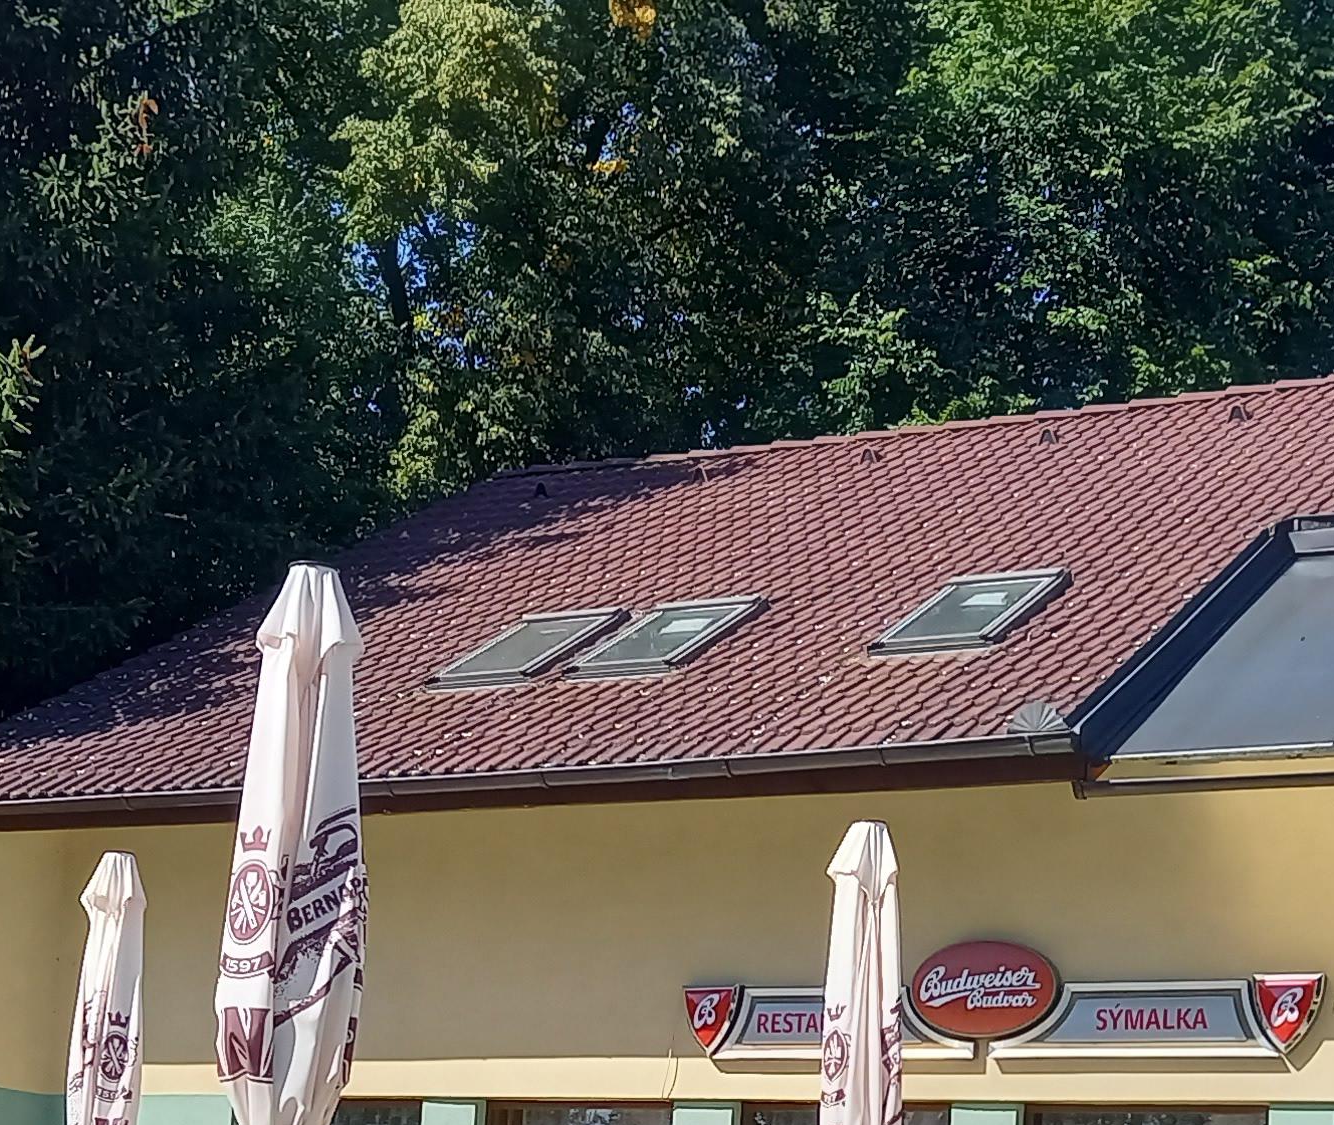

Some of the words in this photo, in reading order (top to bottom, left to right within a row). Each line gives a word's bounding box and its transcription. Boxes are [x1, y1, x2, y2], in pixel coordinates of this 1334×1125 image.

[225, 956, 262, 973] 1597
[919, 965, 1041, 1004] Budweiser
[967, 987, 1037, 1010] Budvar
[1095, 1003, 1208, 1031] SÝMALKA
